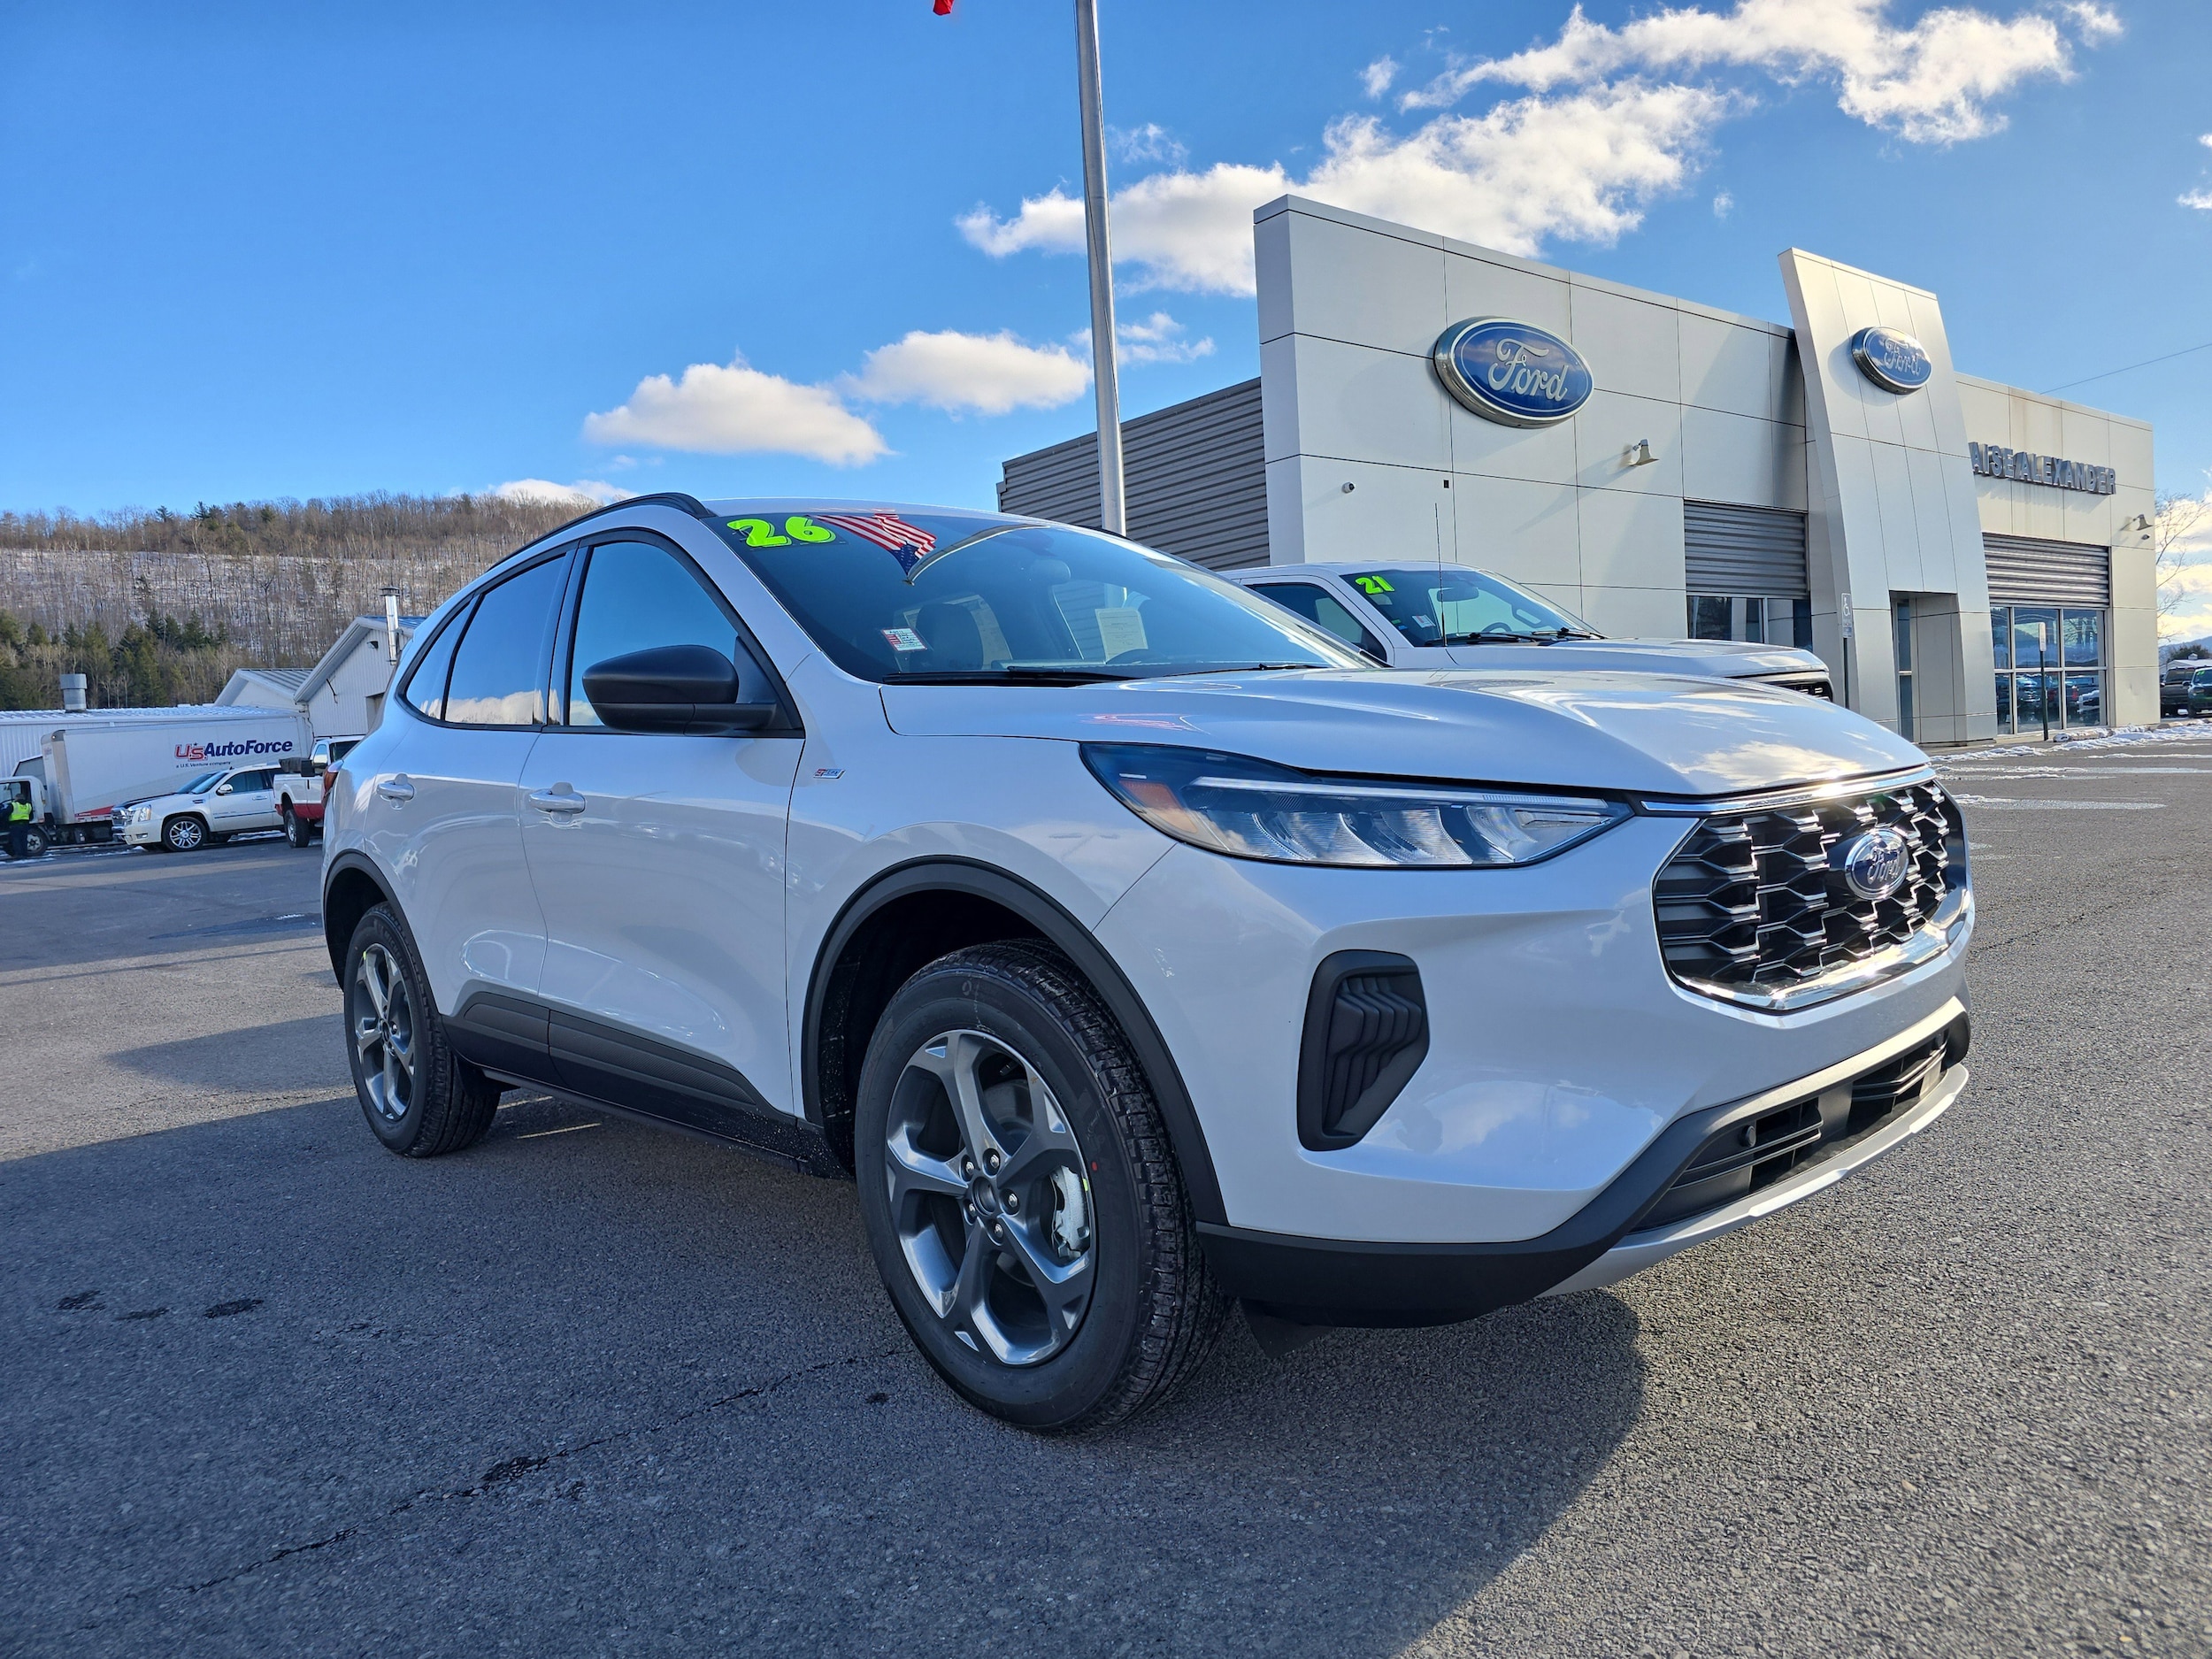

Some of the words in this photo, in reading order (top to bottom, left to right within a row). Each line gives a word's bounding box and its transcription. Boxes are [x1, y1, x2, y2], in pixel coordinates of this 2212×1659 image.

[1487, 338, 1568, 402] Ford
[1884, 337, 1922, 376] Ford
[2014, 450, 2117, 495] ALEXANDER
[726, 516, 836, 548] 26
[1355, 575, 1395, 594] 21
[204, 740, 293, 757] AutoForce
[1867, 845, 1901, 884] Ford
